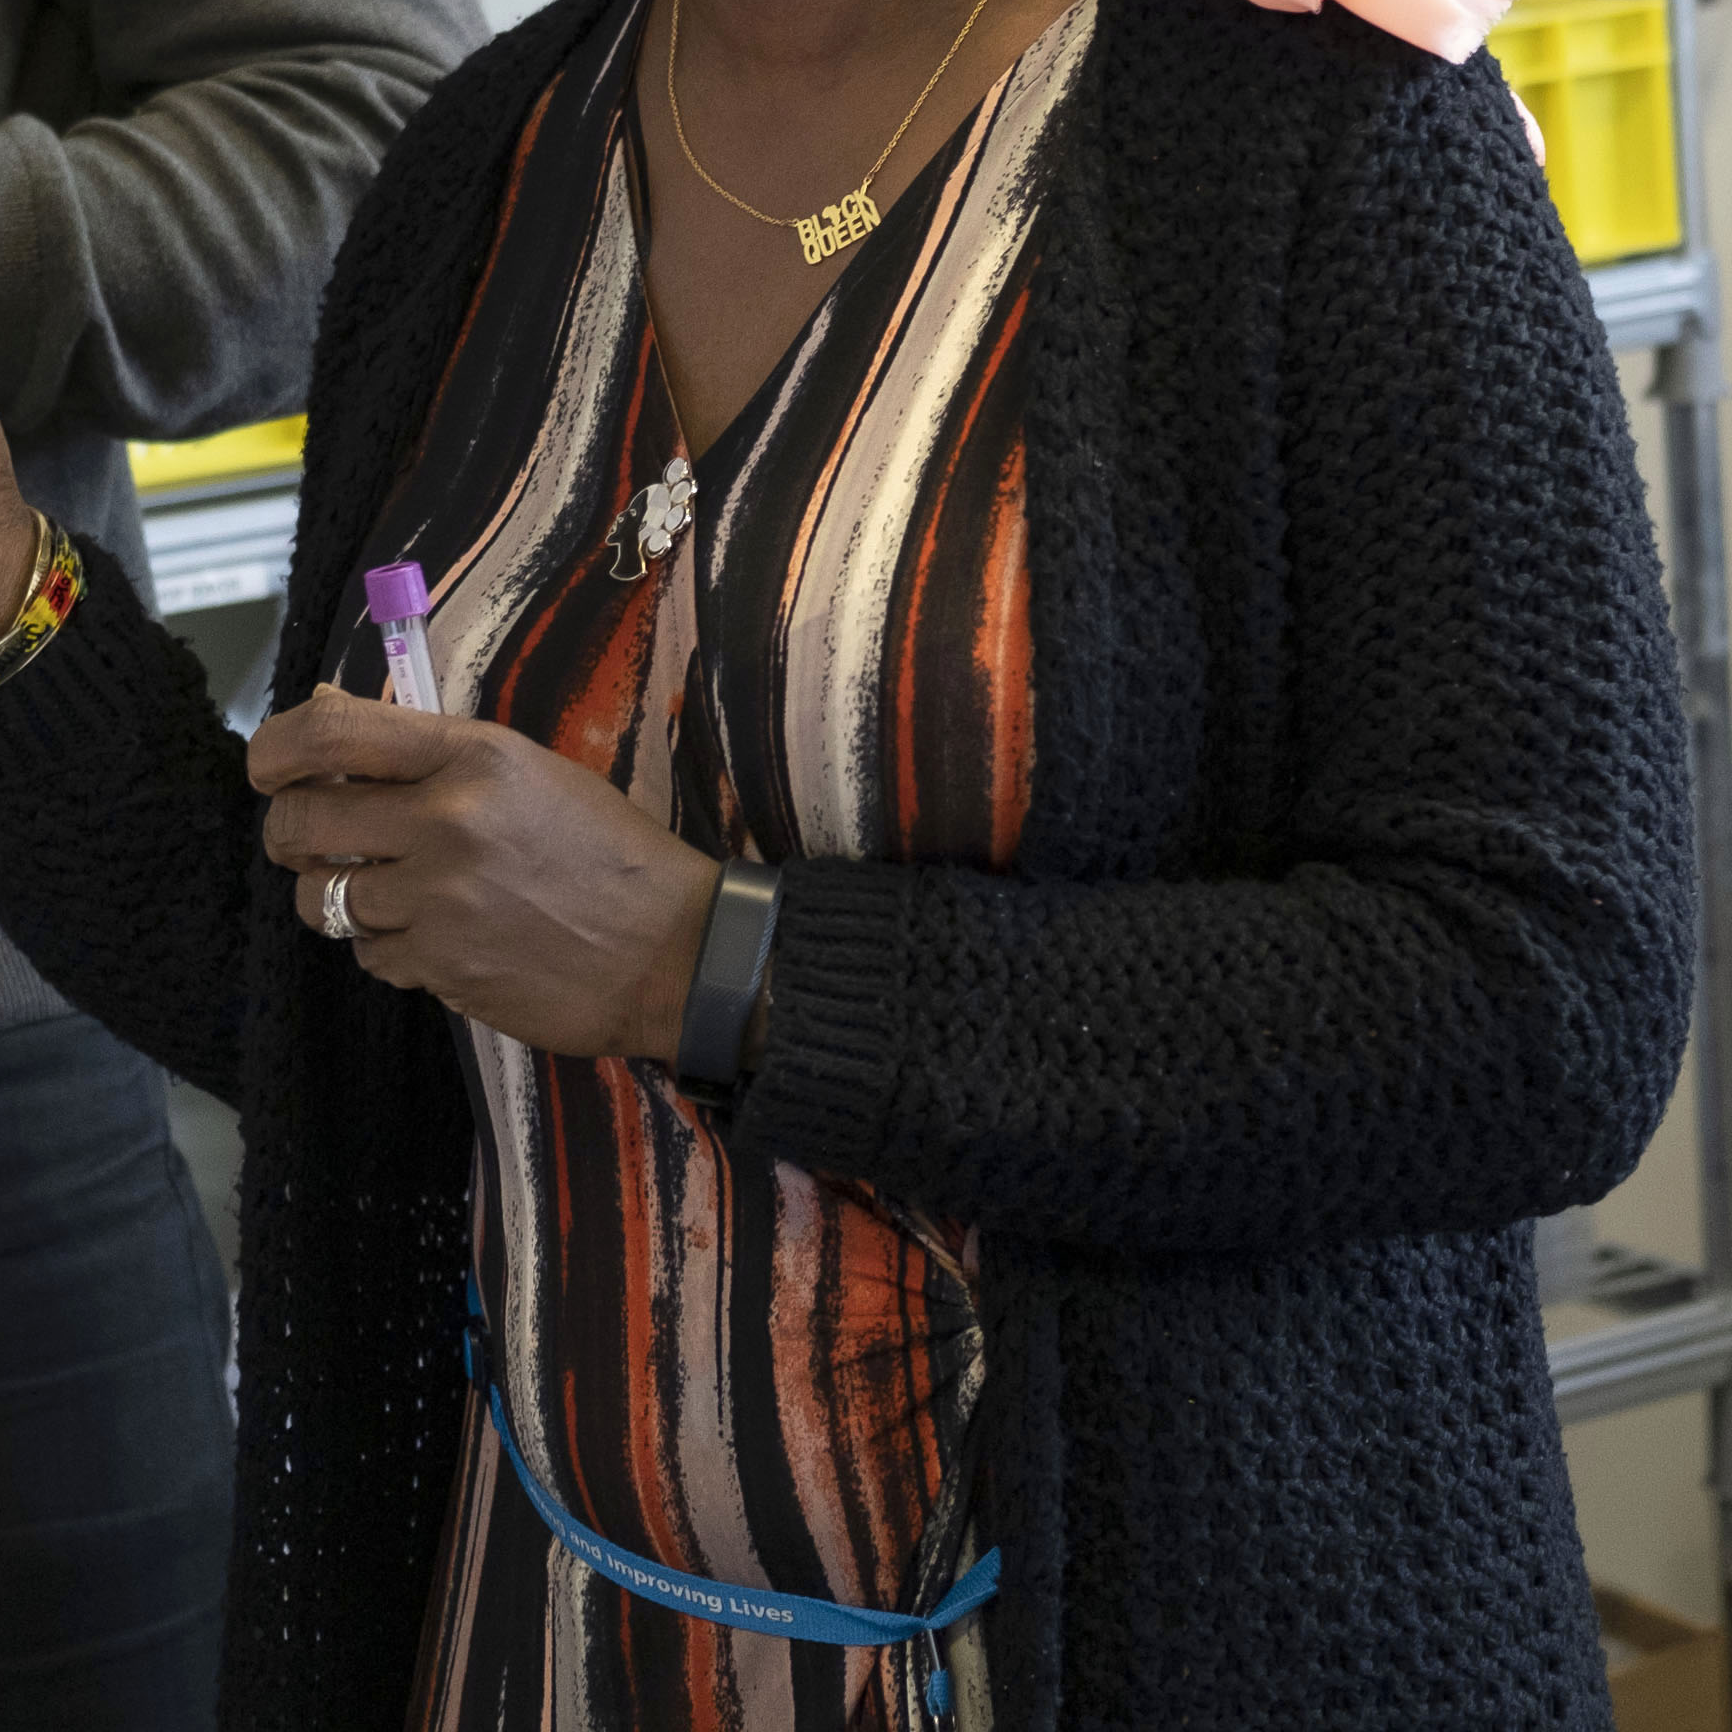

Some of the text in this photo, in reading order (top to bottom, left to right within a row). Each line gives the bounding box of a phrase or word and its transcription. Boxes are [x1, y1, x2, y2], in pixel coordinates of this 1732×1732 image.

[803, 202, 881, 265] QUEEN
[569, 1531, 603, 1561] and
[606, 1553, 723, 1613] Improving
[729, 1598, 795, 1624] Lives
